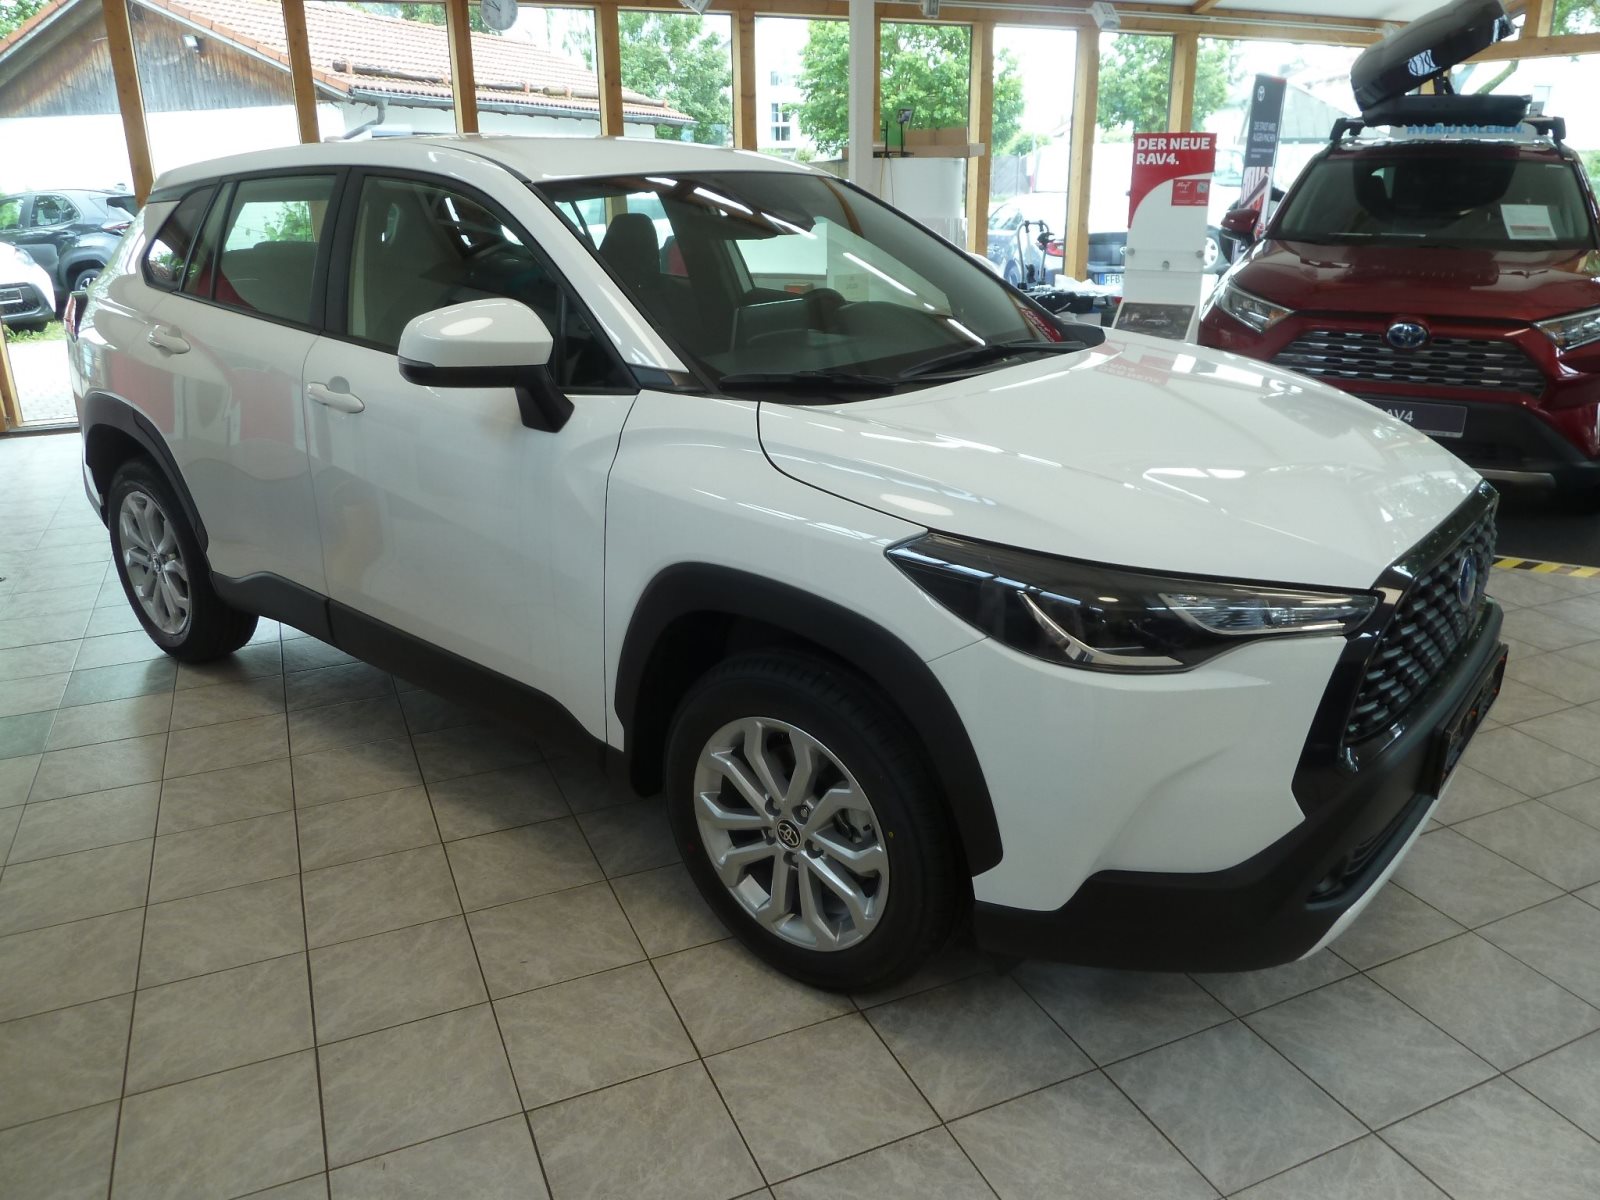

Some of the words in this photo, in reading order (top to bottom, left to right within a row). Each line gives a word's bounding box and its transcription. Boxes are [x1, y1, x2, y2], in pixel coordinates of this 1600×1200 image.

[1137, 137, 1167, 150] DER
[1169, 137, 1211, 150] NEUE
[1136, 152, 1180, 165] RAV4.
[1386, 408, 1414, 422] AV4
